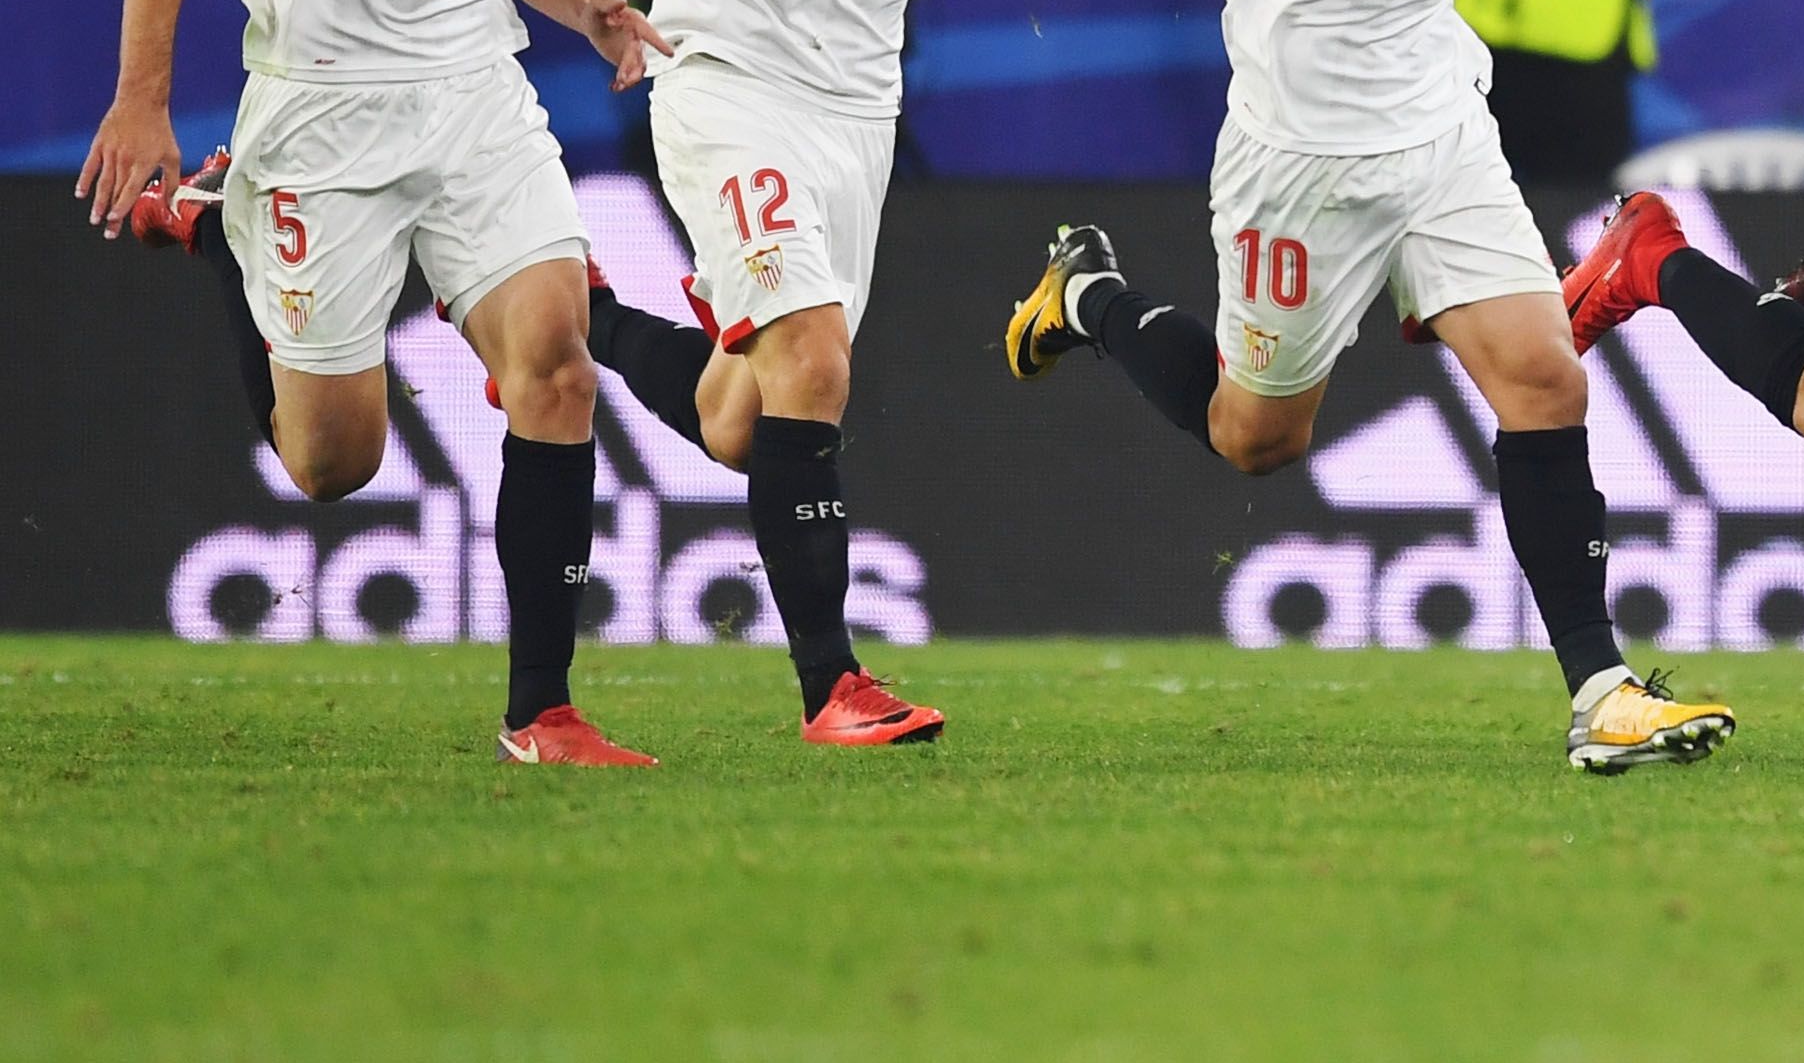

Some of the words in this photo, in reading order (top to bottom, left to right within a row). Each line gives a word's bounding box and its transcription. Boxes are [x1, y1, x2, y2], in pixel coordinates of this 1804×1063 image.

[269, 189, 307, 268] 5
[718, 167, 797, 245] 12
[1232, 228, 1309, 310] 10
[795, 500, 846, 521] SFC
[165, 484, 932, 643] adidas
